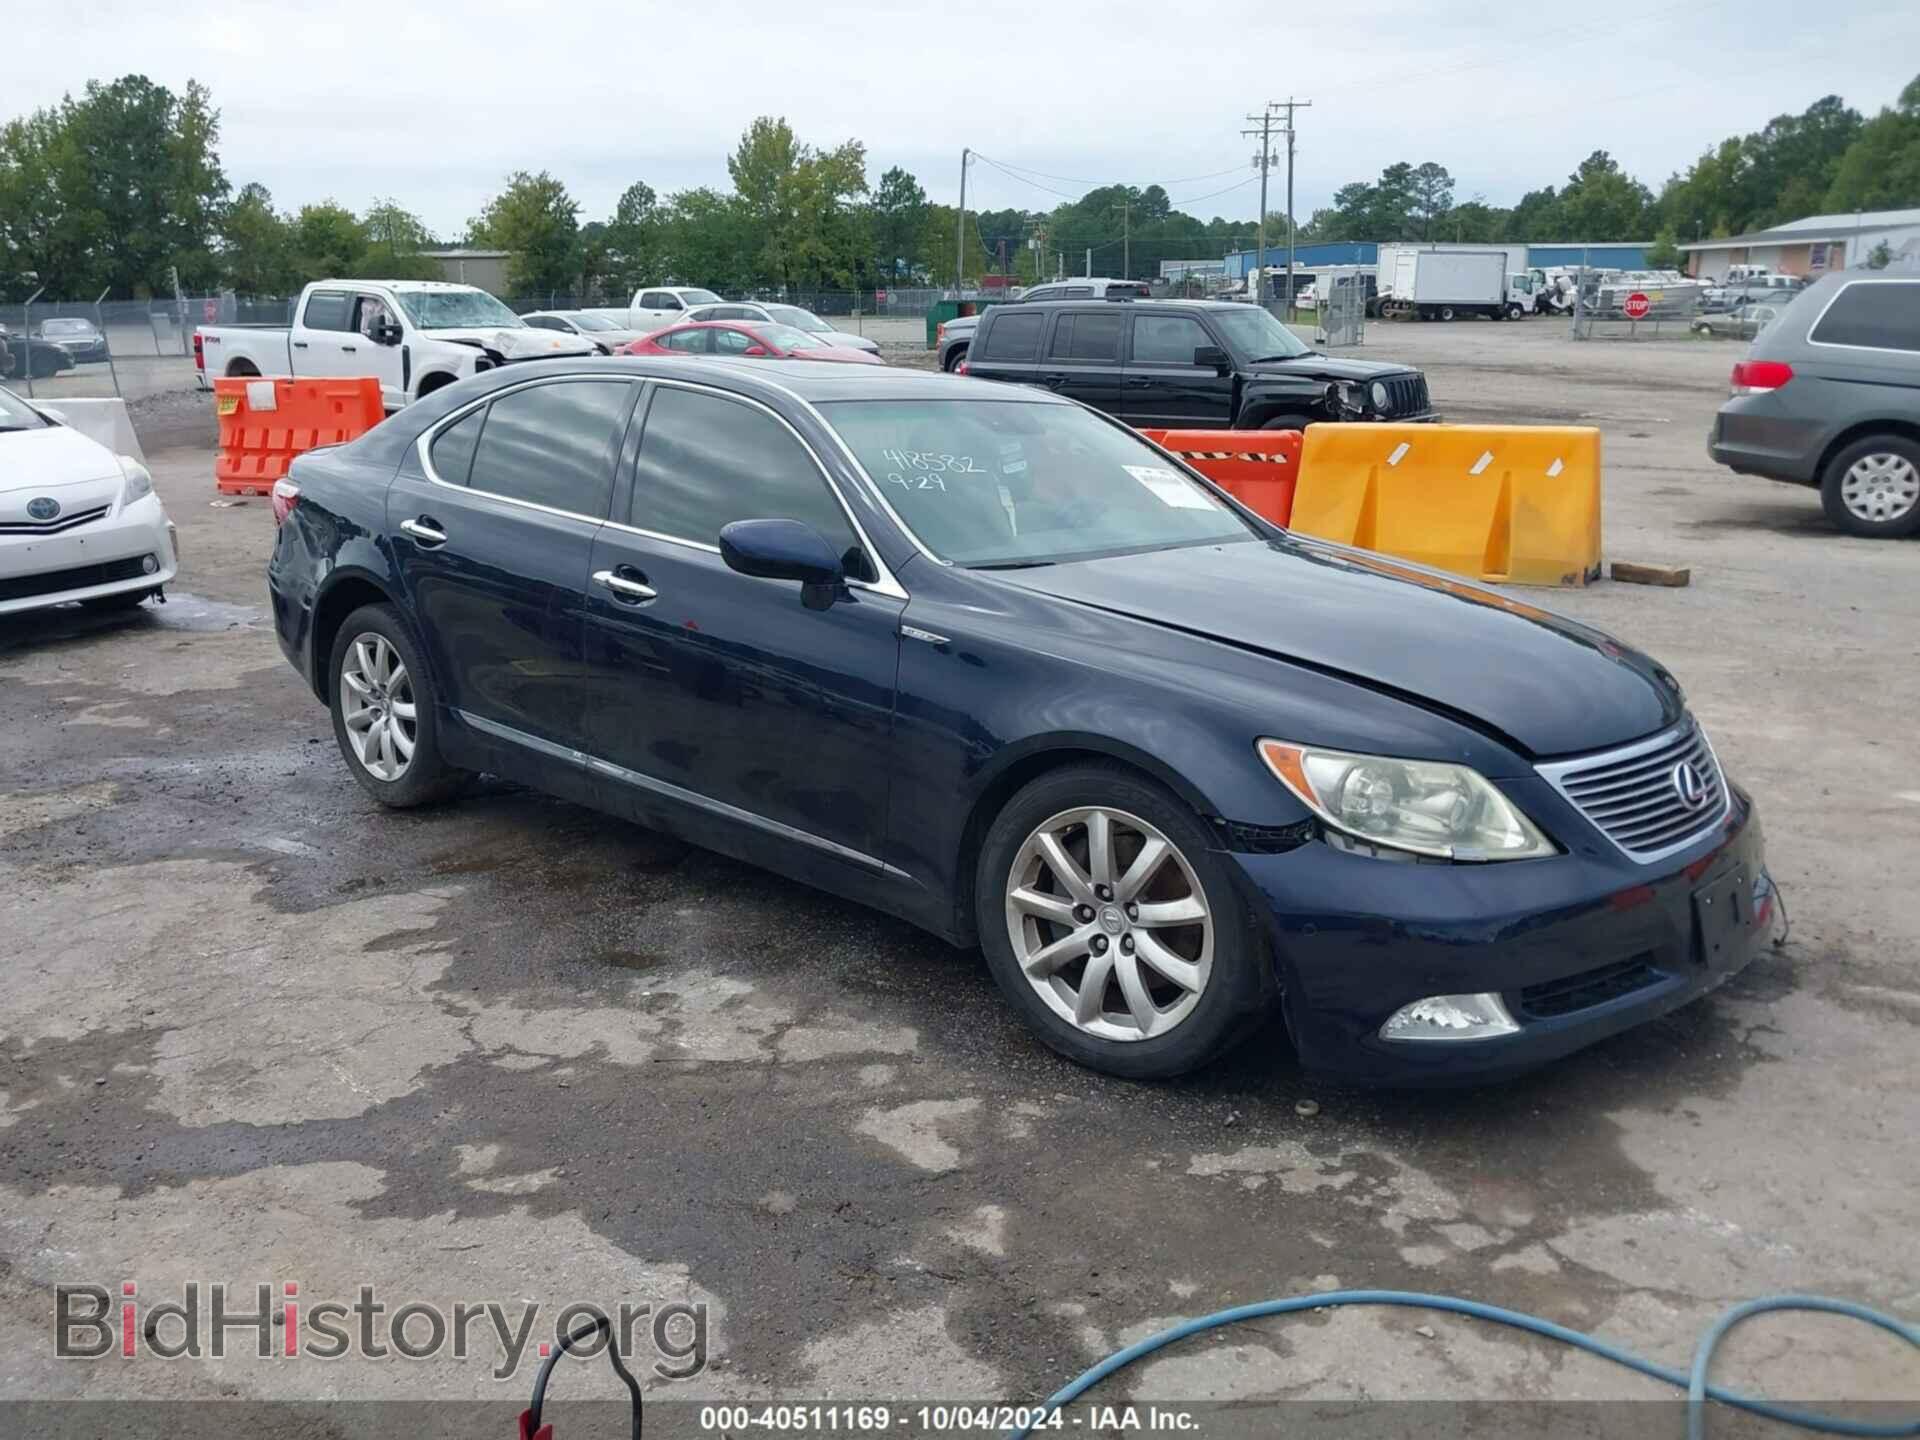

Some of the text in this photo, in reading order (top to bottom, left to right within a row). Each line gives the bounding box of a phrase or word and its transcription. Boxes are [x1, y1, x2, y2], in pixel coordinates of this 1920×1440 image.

[1625, 301, 1648, 310] STOP
[883, 449, 988, 473] 418582
[887, 472, 947, 492] 9-29
